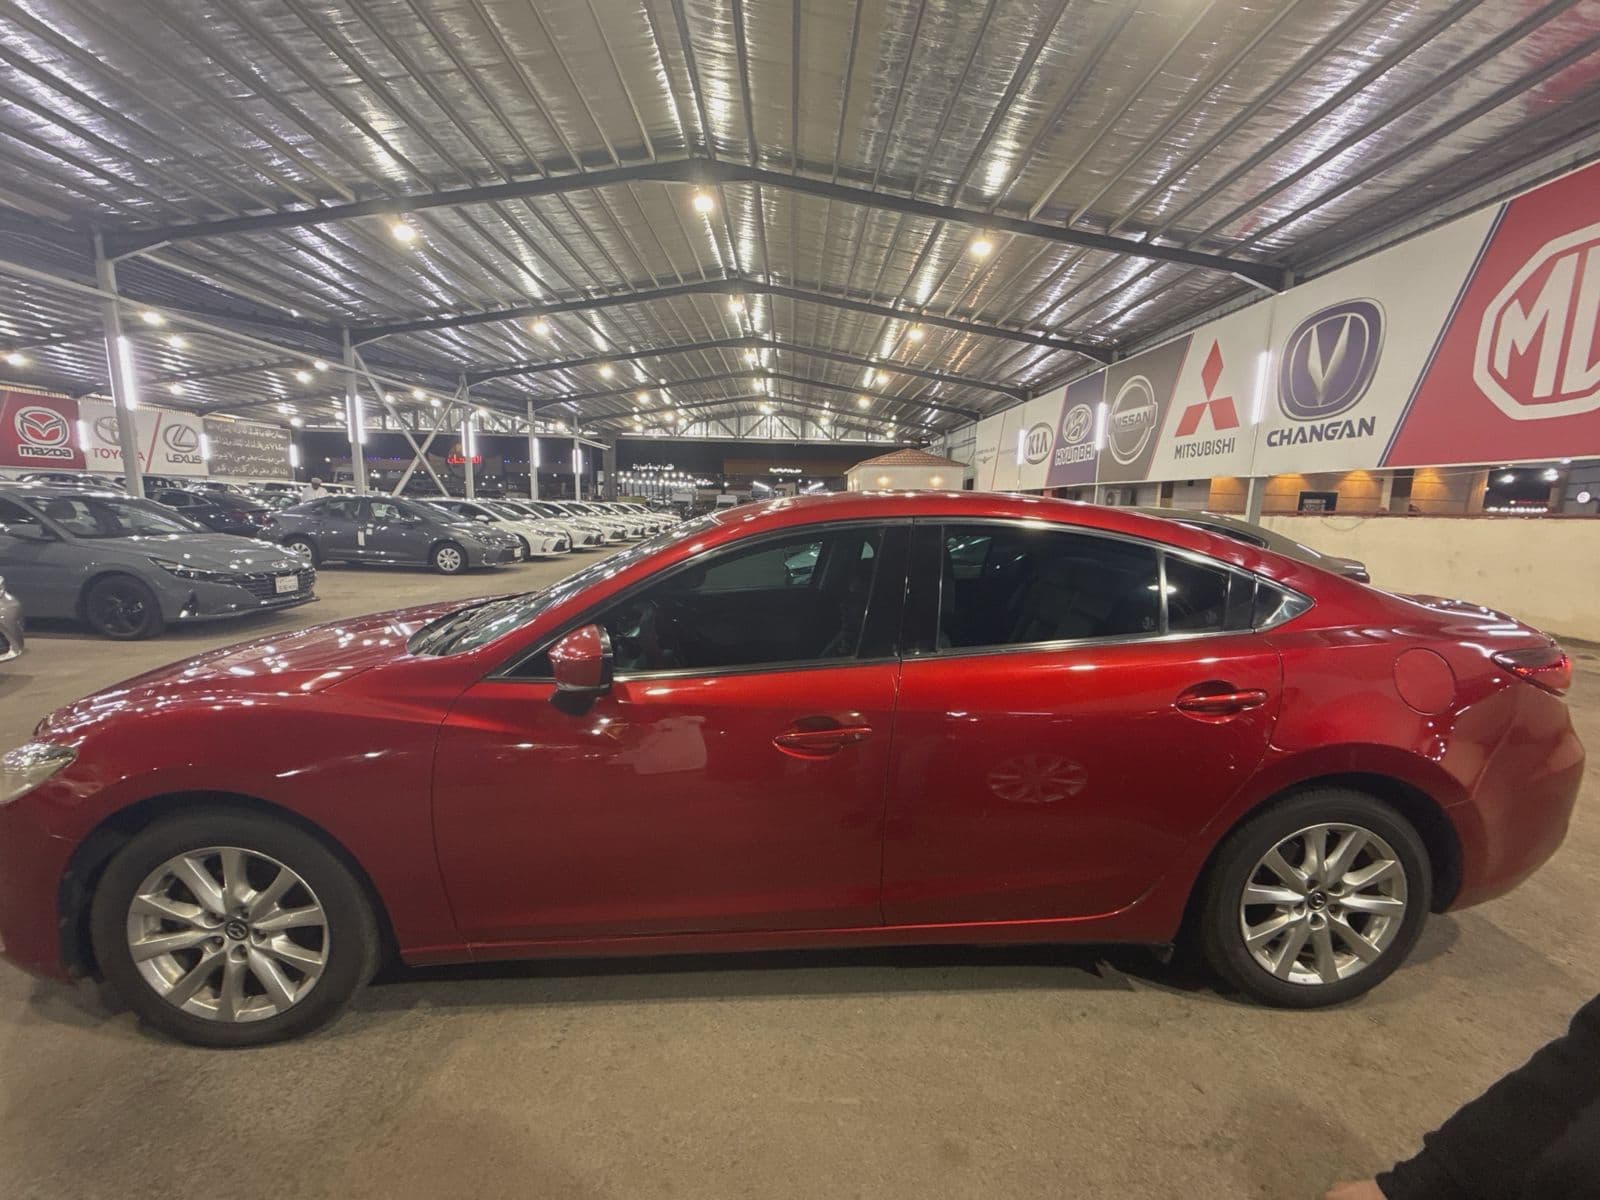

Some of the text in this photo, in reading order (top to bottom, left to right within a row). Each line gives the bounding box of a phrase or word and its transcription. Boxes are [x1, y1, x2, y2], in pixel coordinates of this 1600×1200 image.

[1266, 416, 1376, 447] CHANGAN
[92, 448, 145, 462] TOYA
[1028, 432, 1048, 455] KIA
[1055, 442, 1096, 466] HYUNDAI
[1174, 437, 1235, 460] MITSUBISHI
[166, 453, 202, 464] LEXUS
